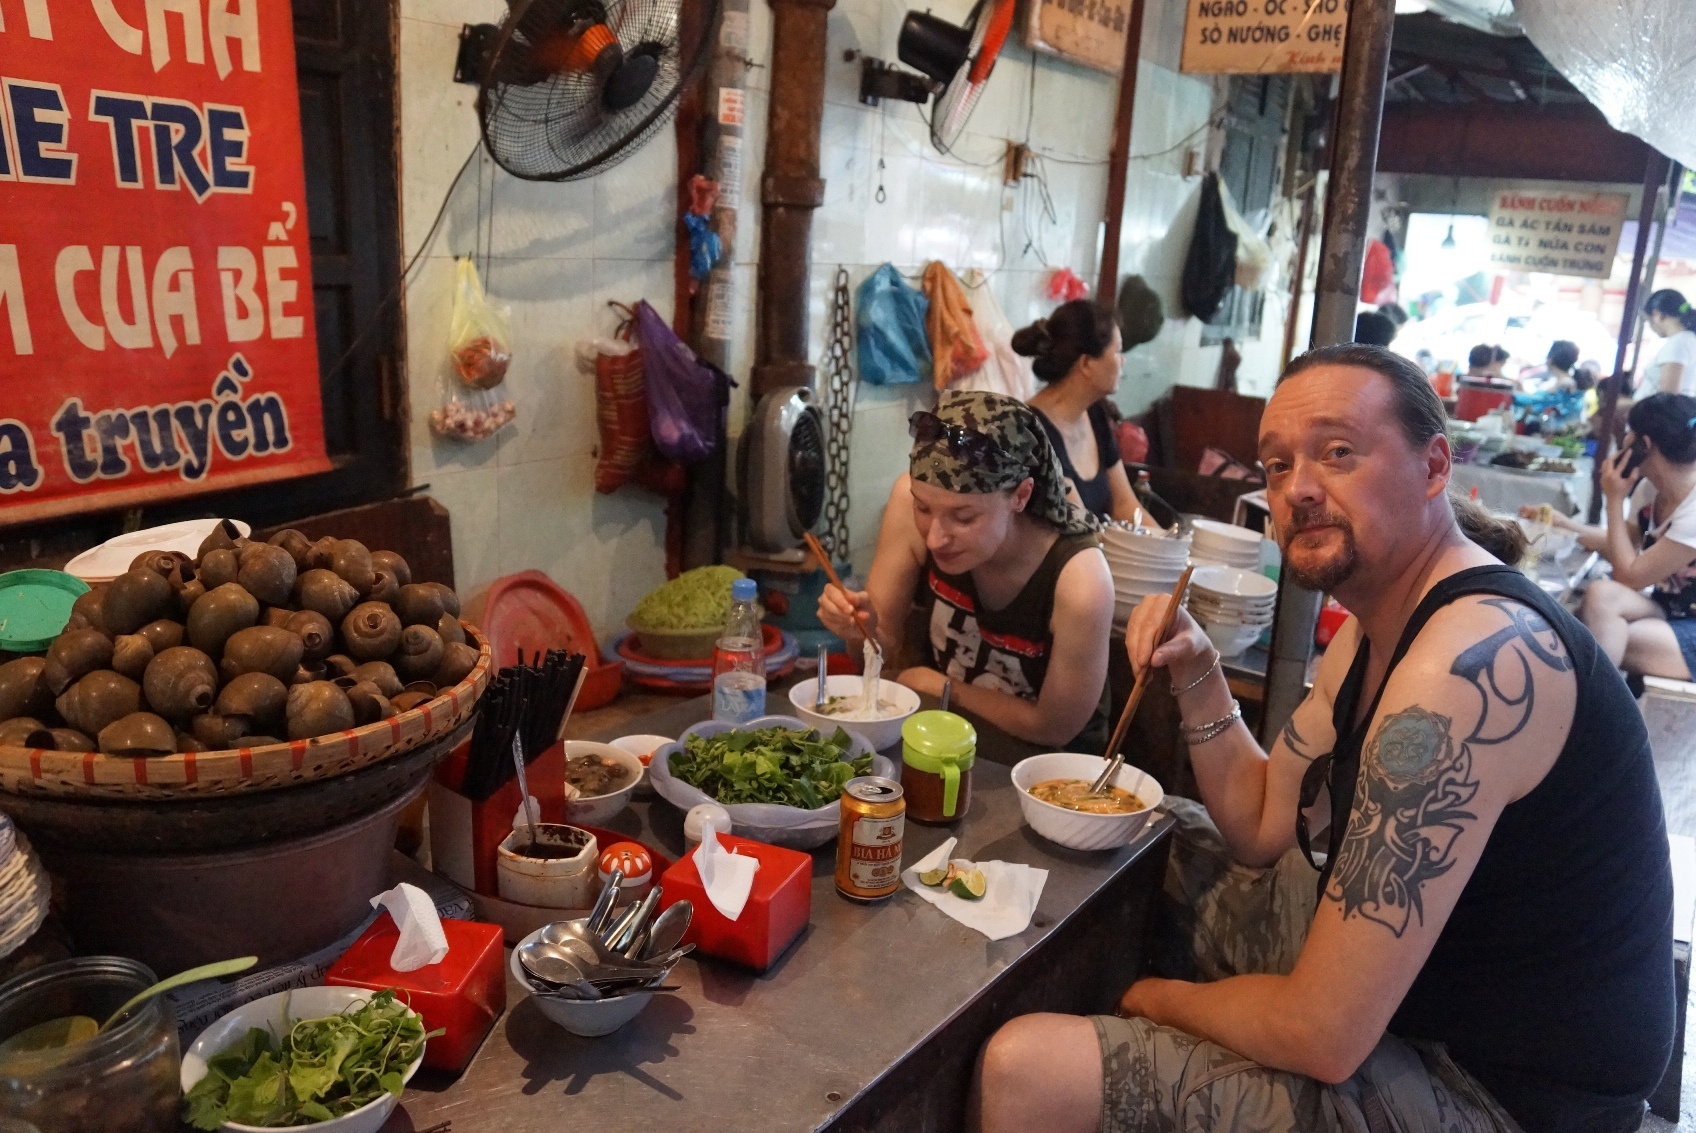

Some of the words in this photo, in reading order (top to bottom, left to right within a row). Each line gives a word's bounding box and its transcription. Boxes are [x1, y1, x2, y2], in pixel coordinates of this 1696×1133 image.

[88, 88, 256, 205] TRE
[54, 244, 201, 360] CUA
[217, 201, 304, 343] BỂ
[50, 353, 293, 481] truyền
[853, 847, 873, 860] BIA
